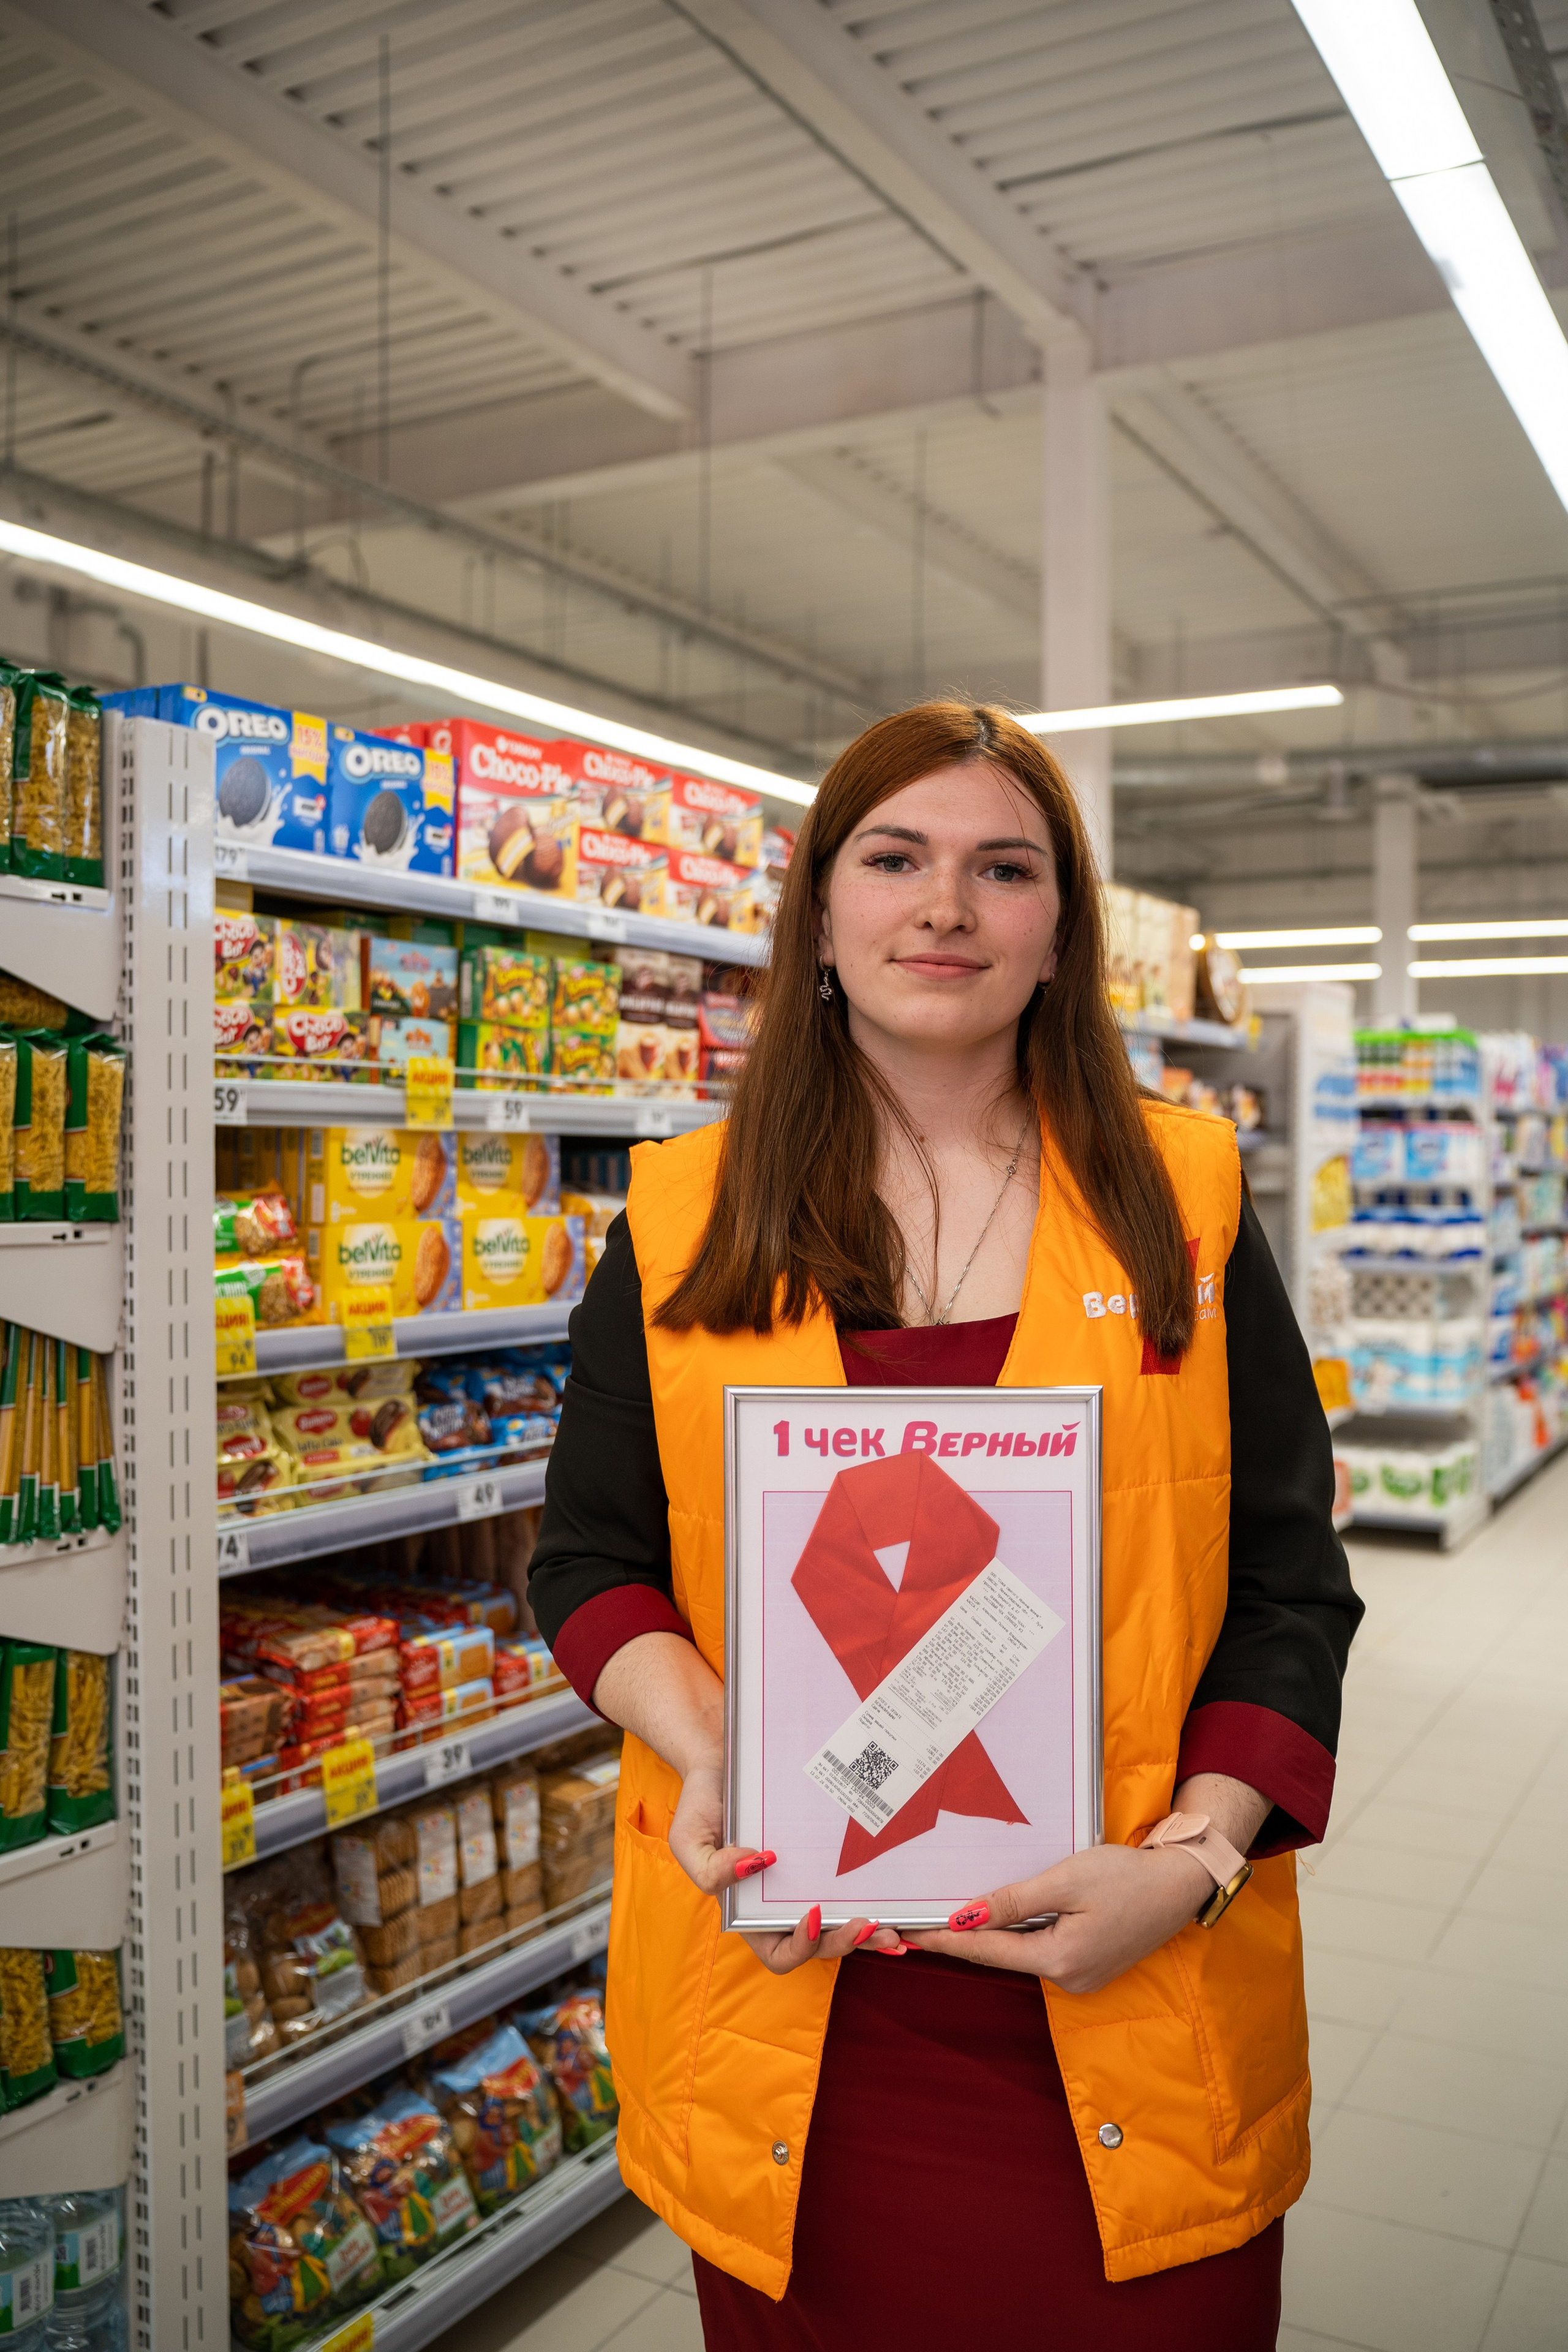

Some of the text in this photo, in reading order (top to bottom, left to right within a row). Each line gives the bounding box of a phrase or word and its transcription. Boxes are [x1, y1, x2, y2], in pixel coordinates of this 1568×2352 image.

[196, 706, 288, 741] OREO
[345, 745, 421, 778] OREO
[214, 1087, 238, 1112] 59
[341, 1136, 401, 1166] belVita
[339, 1232, 402, 1264] belVita
[1082, 1272, 1215, 1319] Вей
[773, 1420, 790, 1457] 1
[804, 1428, 886, 1457] чек
[982, 1580, 997, 1593] проспект
[998, 1587, 1022, 1609] Ленинградская
[983, 1595, 998, 1609] КАССОВЫЙ
[861, 1714, 873, 1725] Скидка
[877, 1696, 888, 1706] ИТОГО
[890, 1708, 902, 1719] ОПЛАТЕ
[858, 1717, 871, 1730] Подитог
[864, 1710, 874, 1721] Сумма
[883, 1728, 897, 1741] покупки
